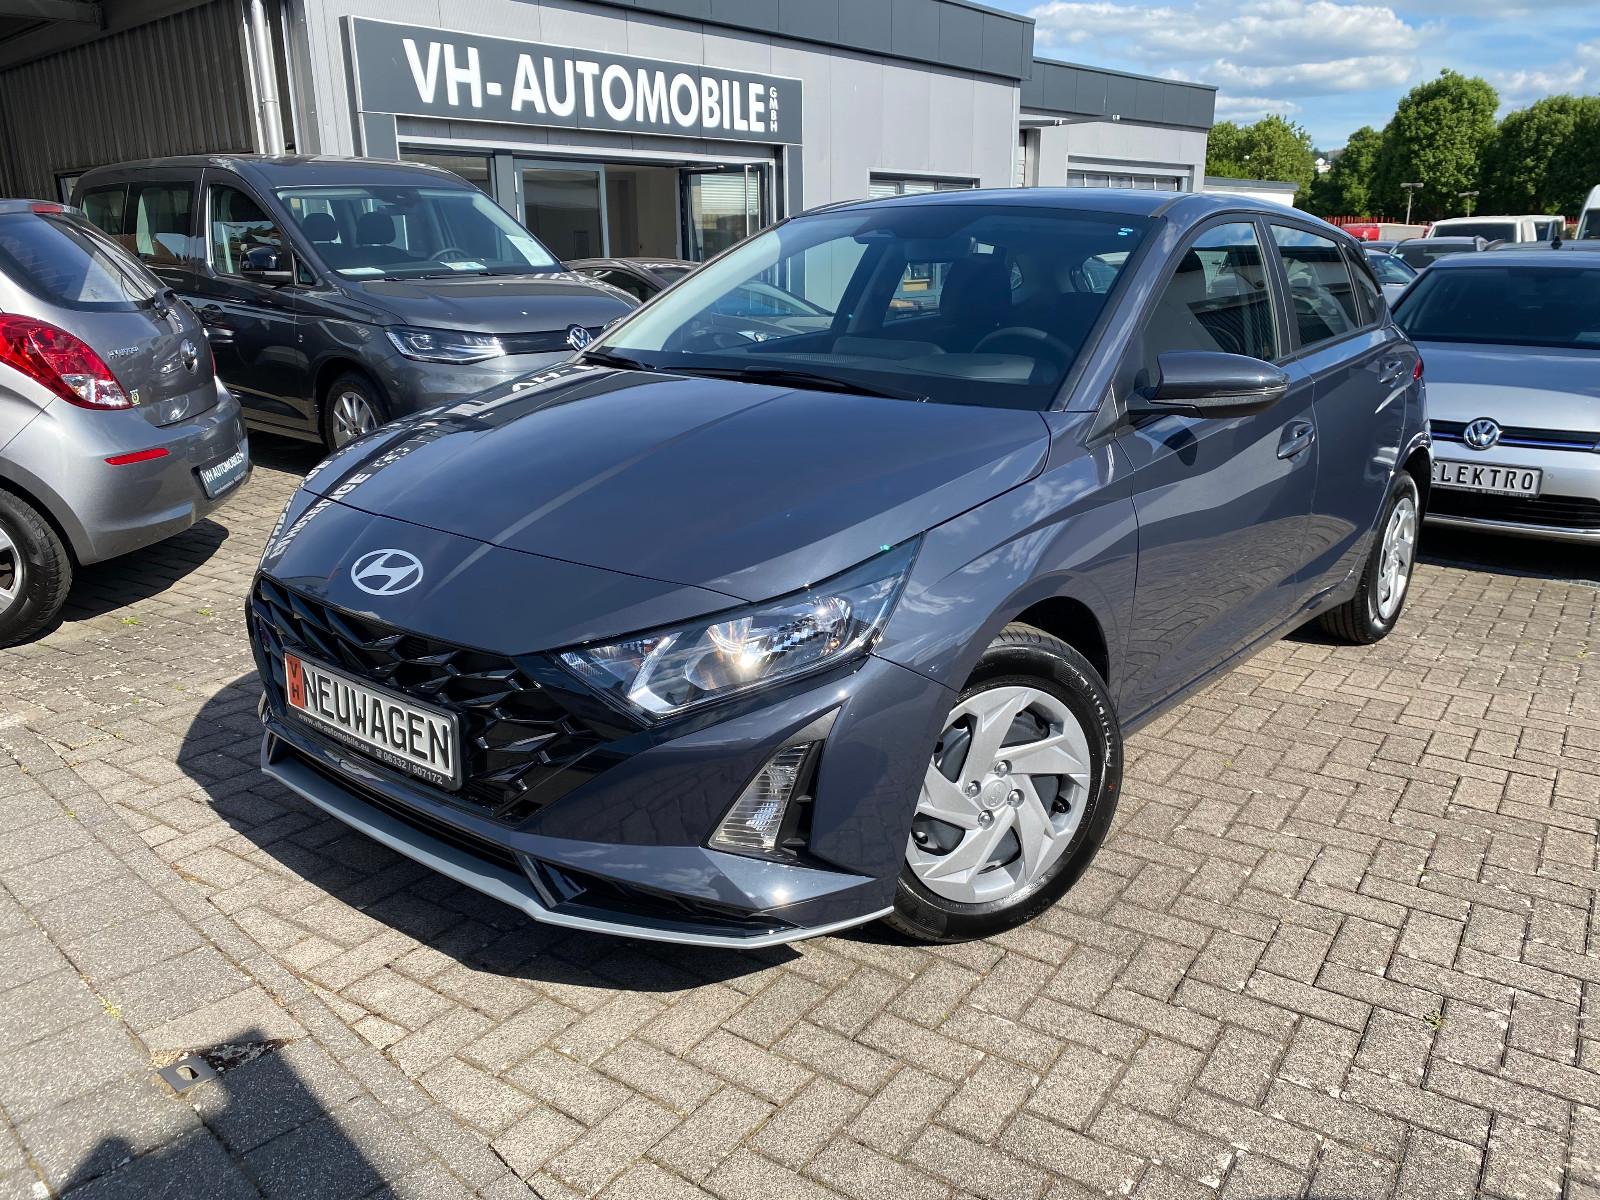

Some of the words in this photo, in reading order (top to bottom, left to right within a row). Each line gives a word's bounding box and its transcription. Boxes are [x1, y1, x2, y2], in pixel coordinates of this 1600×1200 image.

[769, 86, 778, 132] GMBH
[205, 469, 214, 484] VH
[289, 662, 300, 698] VH
[302, 667, 450, 769] NEUWAGEN
[298, 713, 370, 753] www.vh-automobile.eu
[383, 752, 407, 769] 06332
[412, 765, 443, 785] 907172
